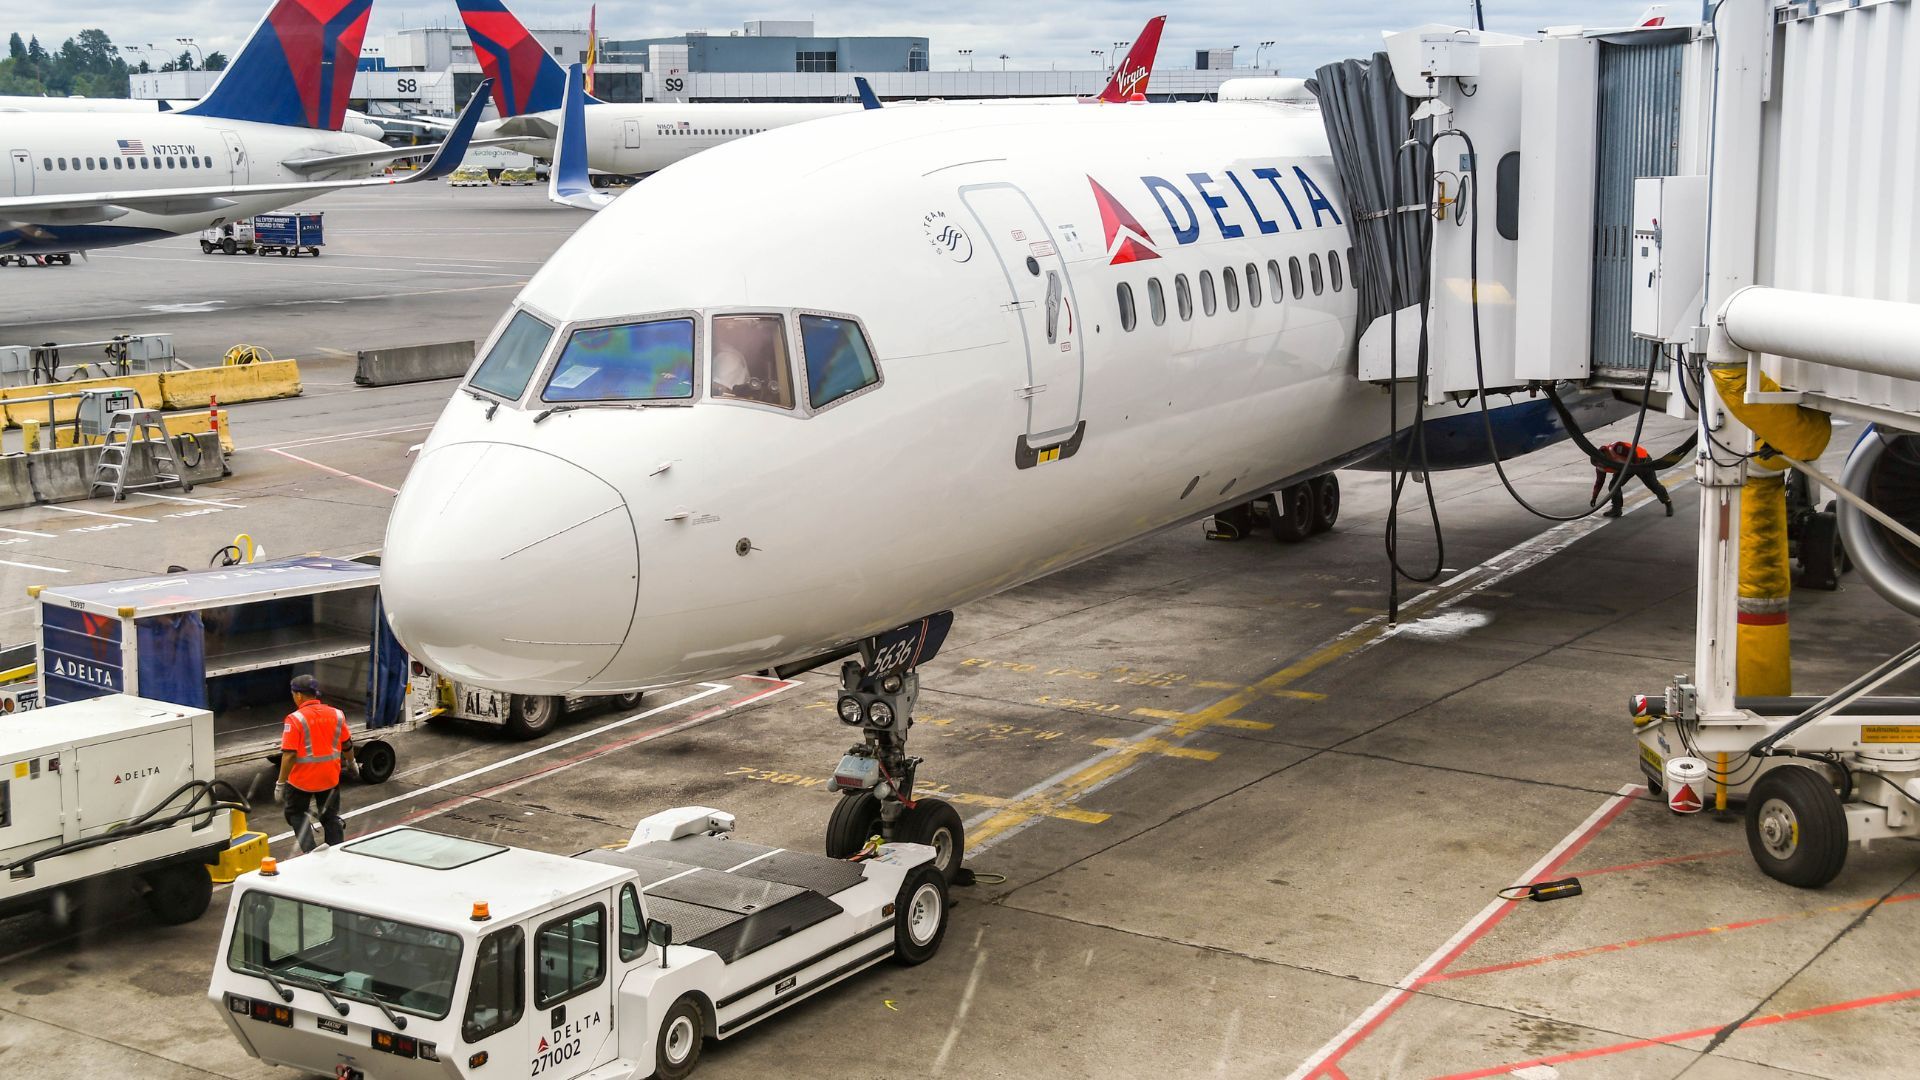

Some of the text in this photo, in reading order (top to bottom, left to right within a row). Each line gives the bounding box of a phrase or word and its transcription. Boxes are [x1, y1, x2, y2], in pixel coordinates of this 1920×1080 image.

[397, 78, 417, 93] S8
[665, 78, 684, 92] S9
[1116, 57, 1149, 97] Virgin
[152, 145, 195, 155] N713TW
[1140, 165, 1343, 245] DELTA
[868, 635, 916, 677] 5636
[68, 661, 113, 686] DELTA
[125, 766, 161, 782] DELTA
[553, 1011, 601, 1045] DELTA
[531, 1038, 581, 1077] 271002
